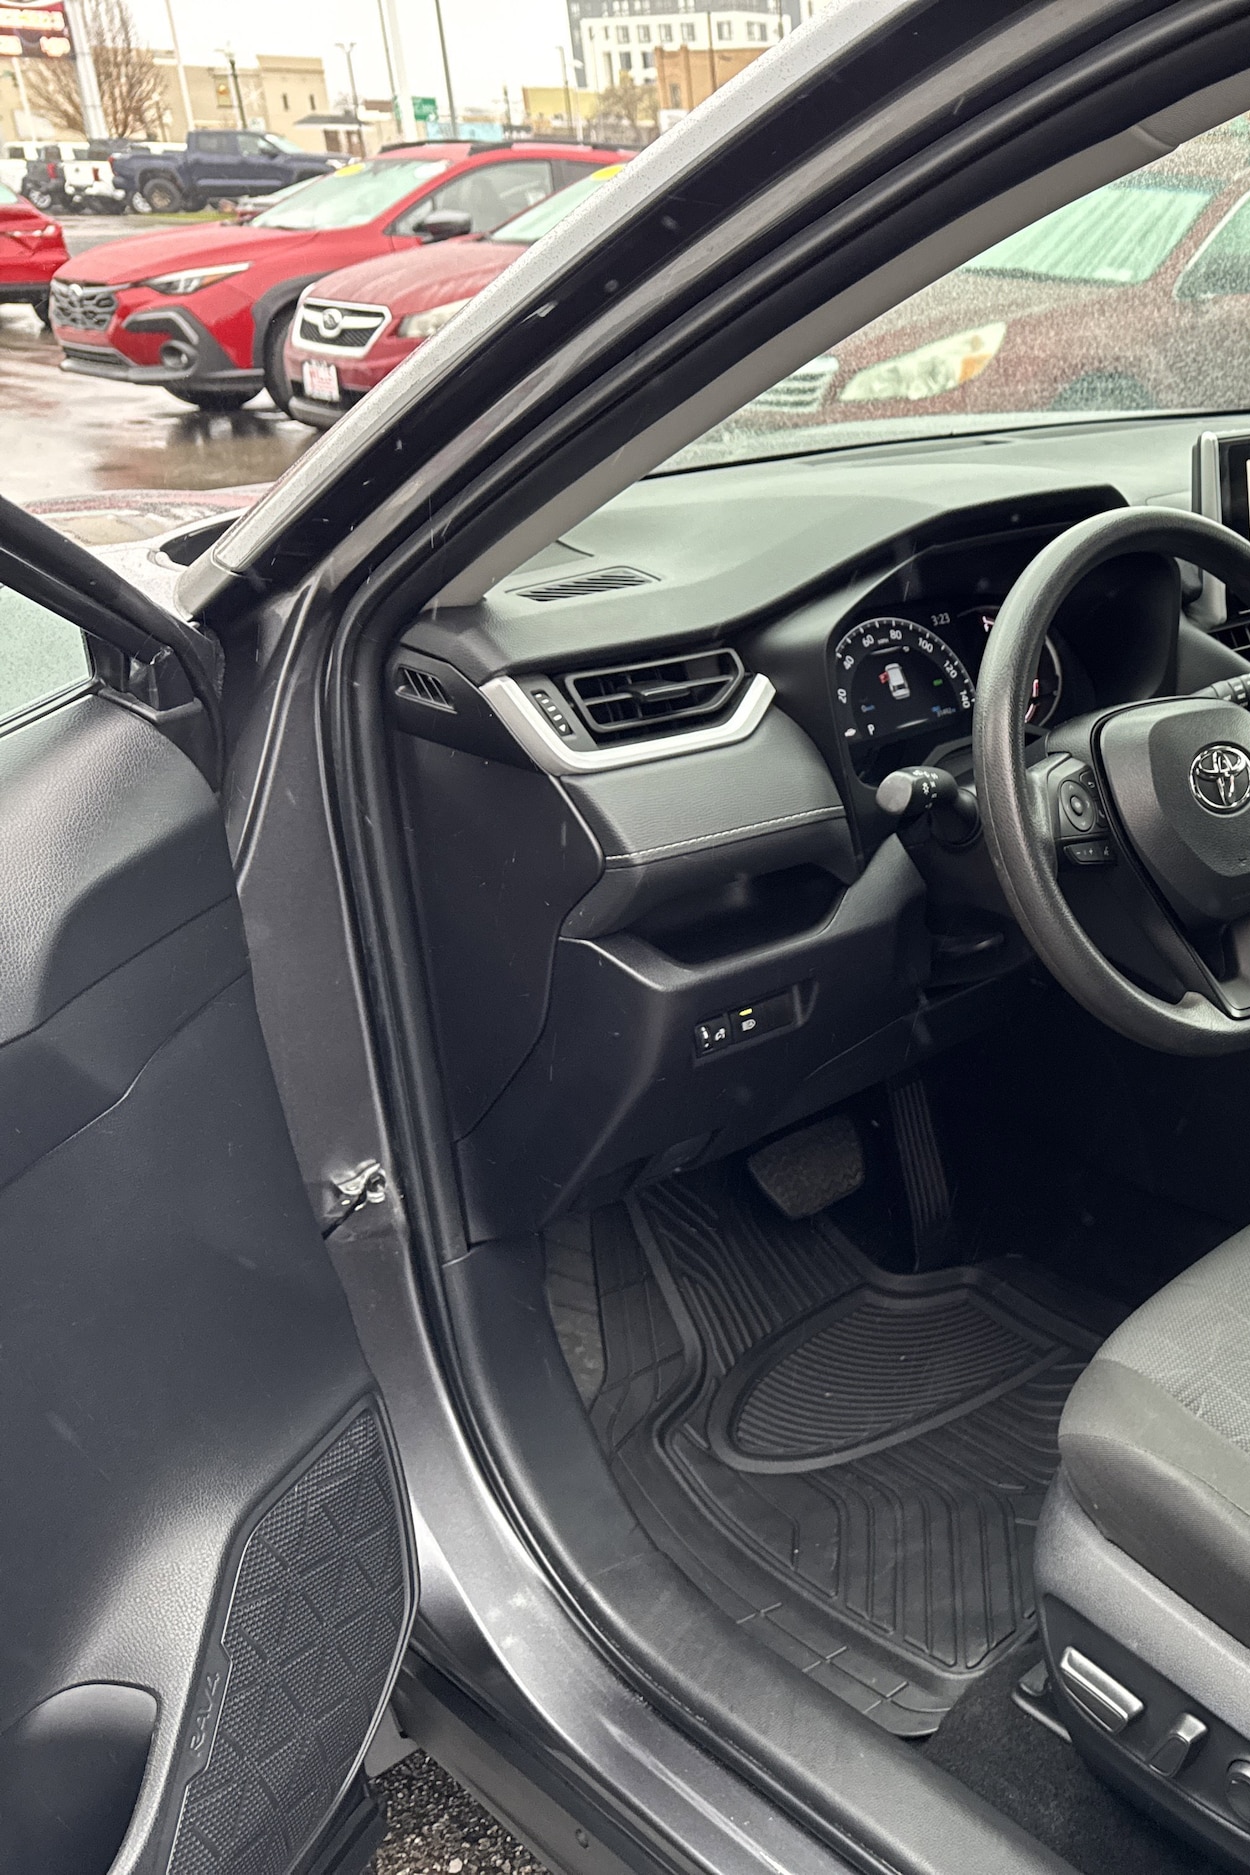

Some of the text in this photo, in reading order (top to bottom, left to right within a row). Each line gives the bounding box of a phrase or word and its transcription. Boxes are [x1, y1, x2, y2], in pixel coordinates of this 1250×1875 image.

[931, 612, 951, 627] 3:23
[862, 634, 875, 648] 60
[889, 629, 902, 640] 80
[917, 637, 934, 653] 100
[843, 654, 855, 671] 40
[943, 660, 958, 679] 120
[837, 688, 847, 704] 20
[959, 689, 971, 709] 140
[867, 724, 876, 736] P
[190, 1672, 220, 1758] RAV4
